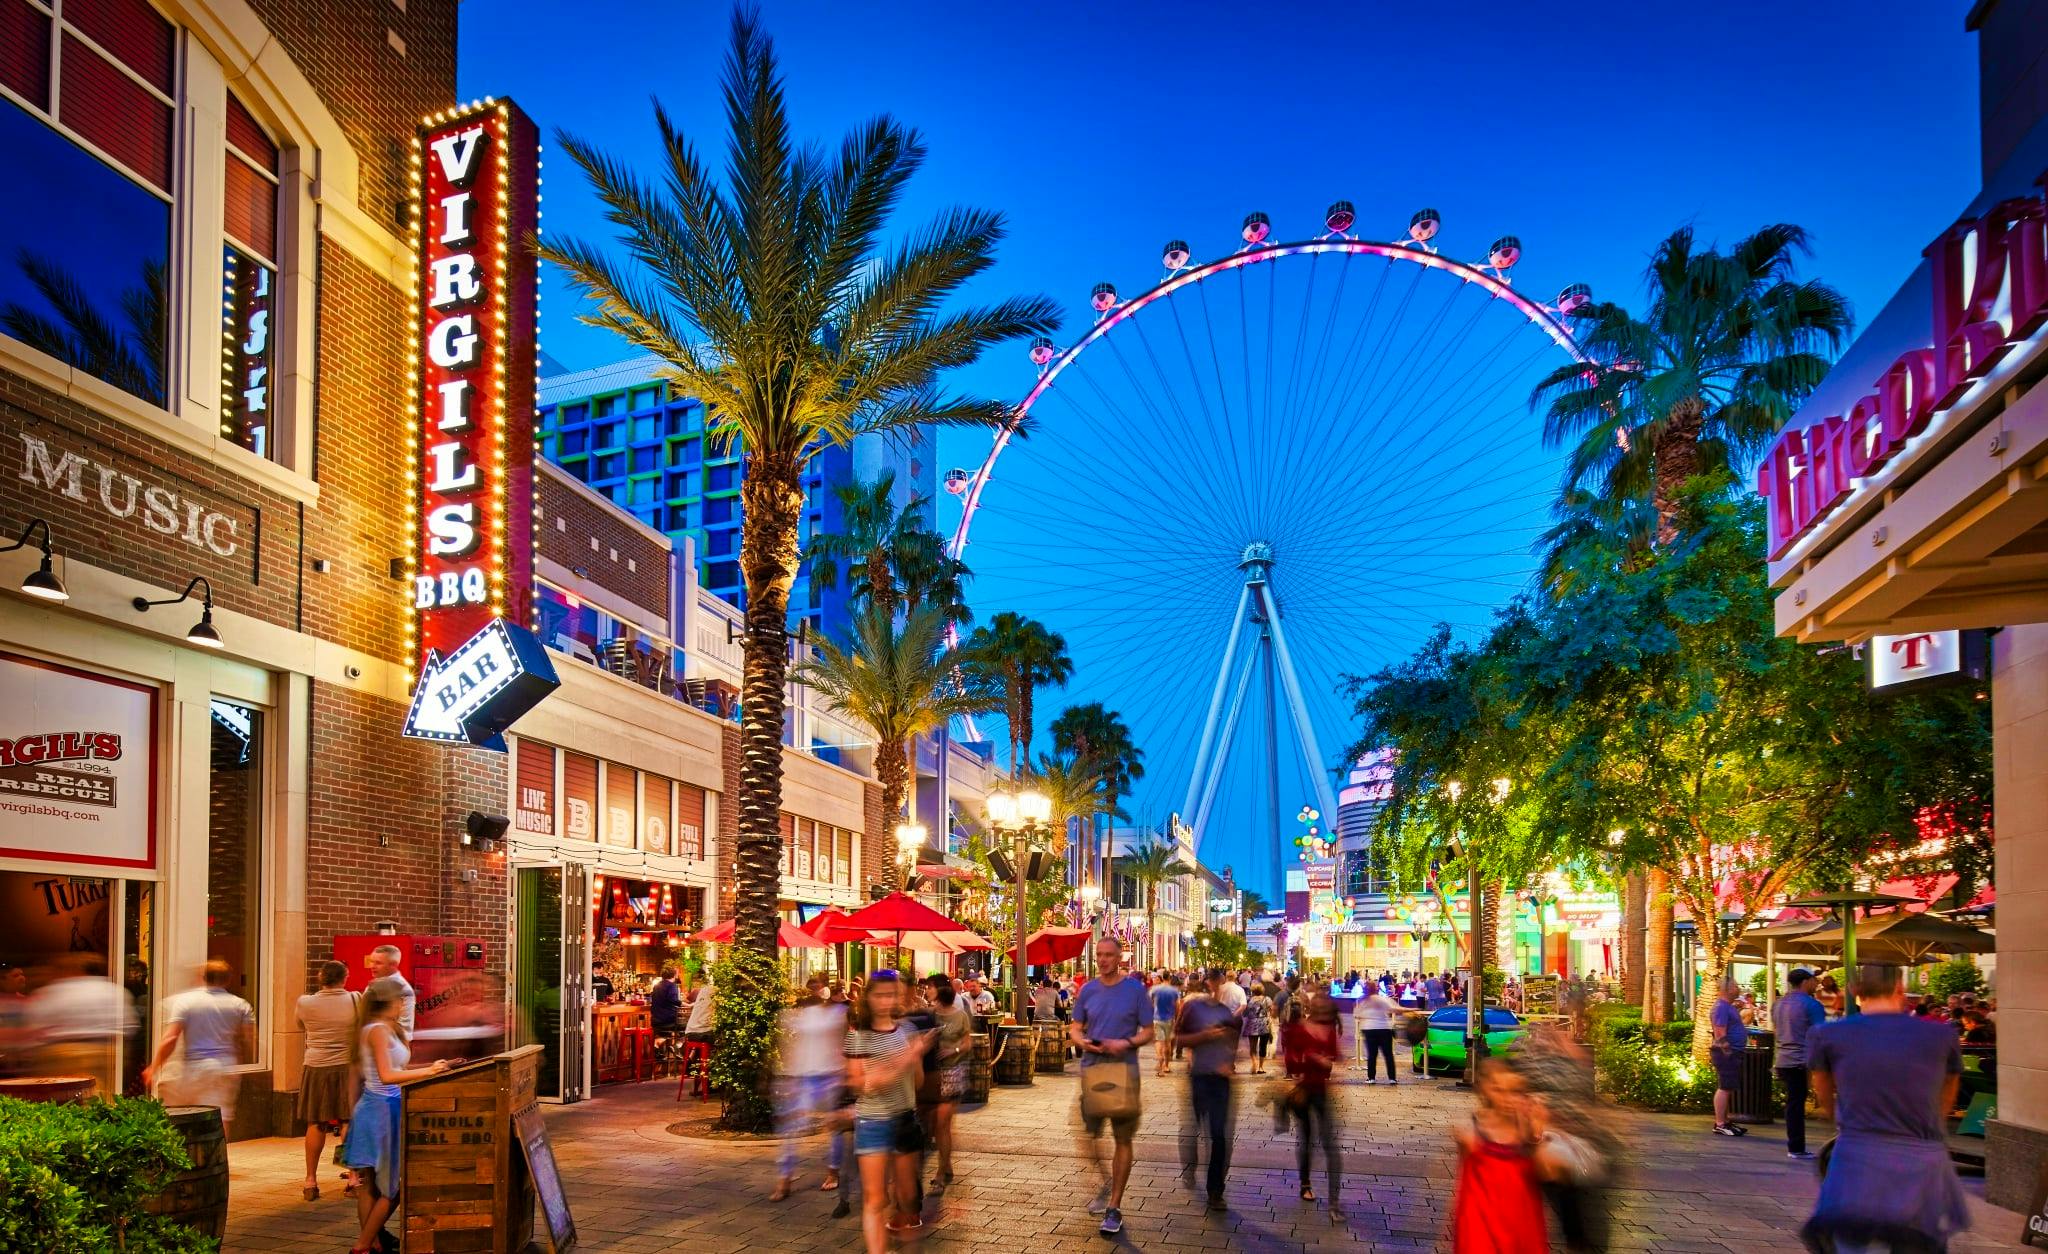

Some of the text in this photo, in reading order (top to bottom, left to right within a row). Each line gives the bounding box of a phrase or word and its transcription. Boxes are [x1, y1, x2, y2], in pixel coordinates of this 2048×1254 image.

[427, 127, 483, 556] VIRGILS
[18, 432, 237, 557] MUSIC
[415, 567, 487, 609] BBQ
[434, 651, 499, 713] BAR
[36, 772, 110, 791] REAL
[523, 787, 546, 811] LIVE
[516, 809, 552, 834] MUSIC
[681, 823, 699, 843] FULL
[681, 841, 698, 861] BAR
[421, 1116, 485, 1128] VIRGILS
